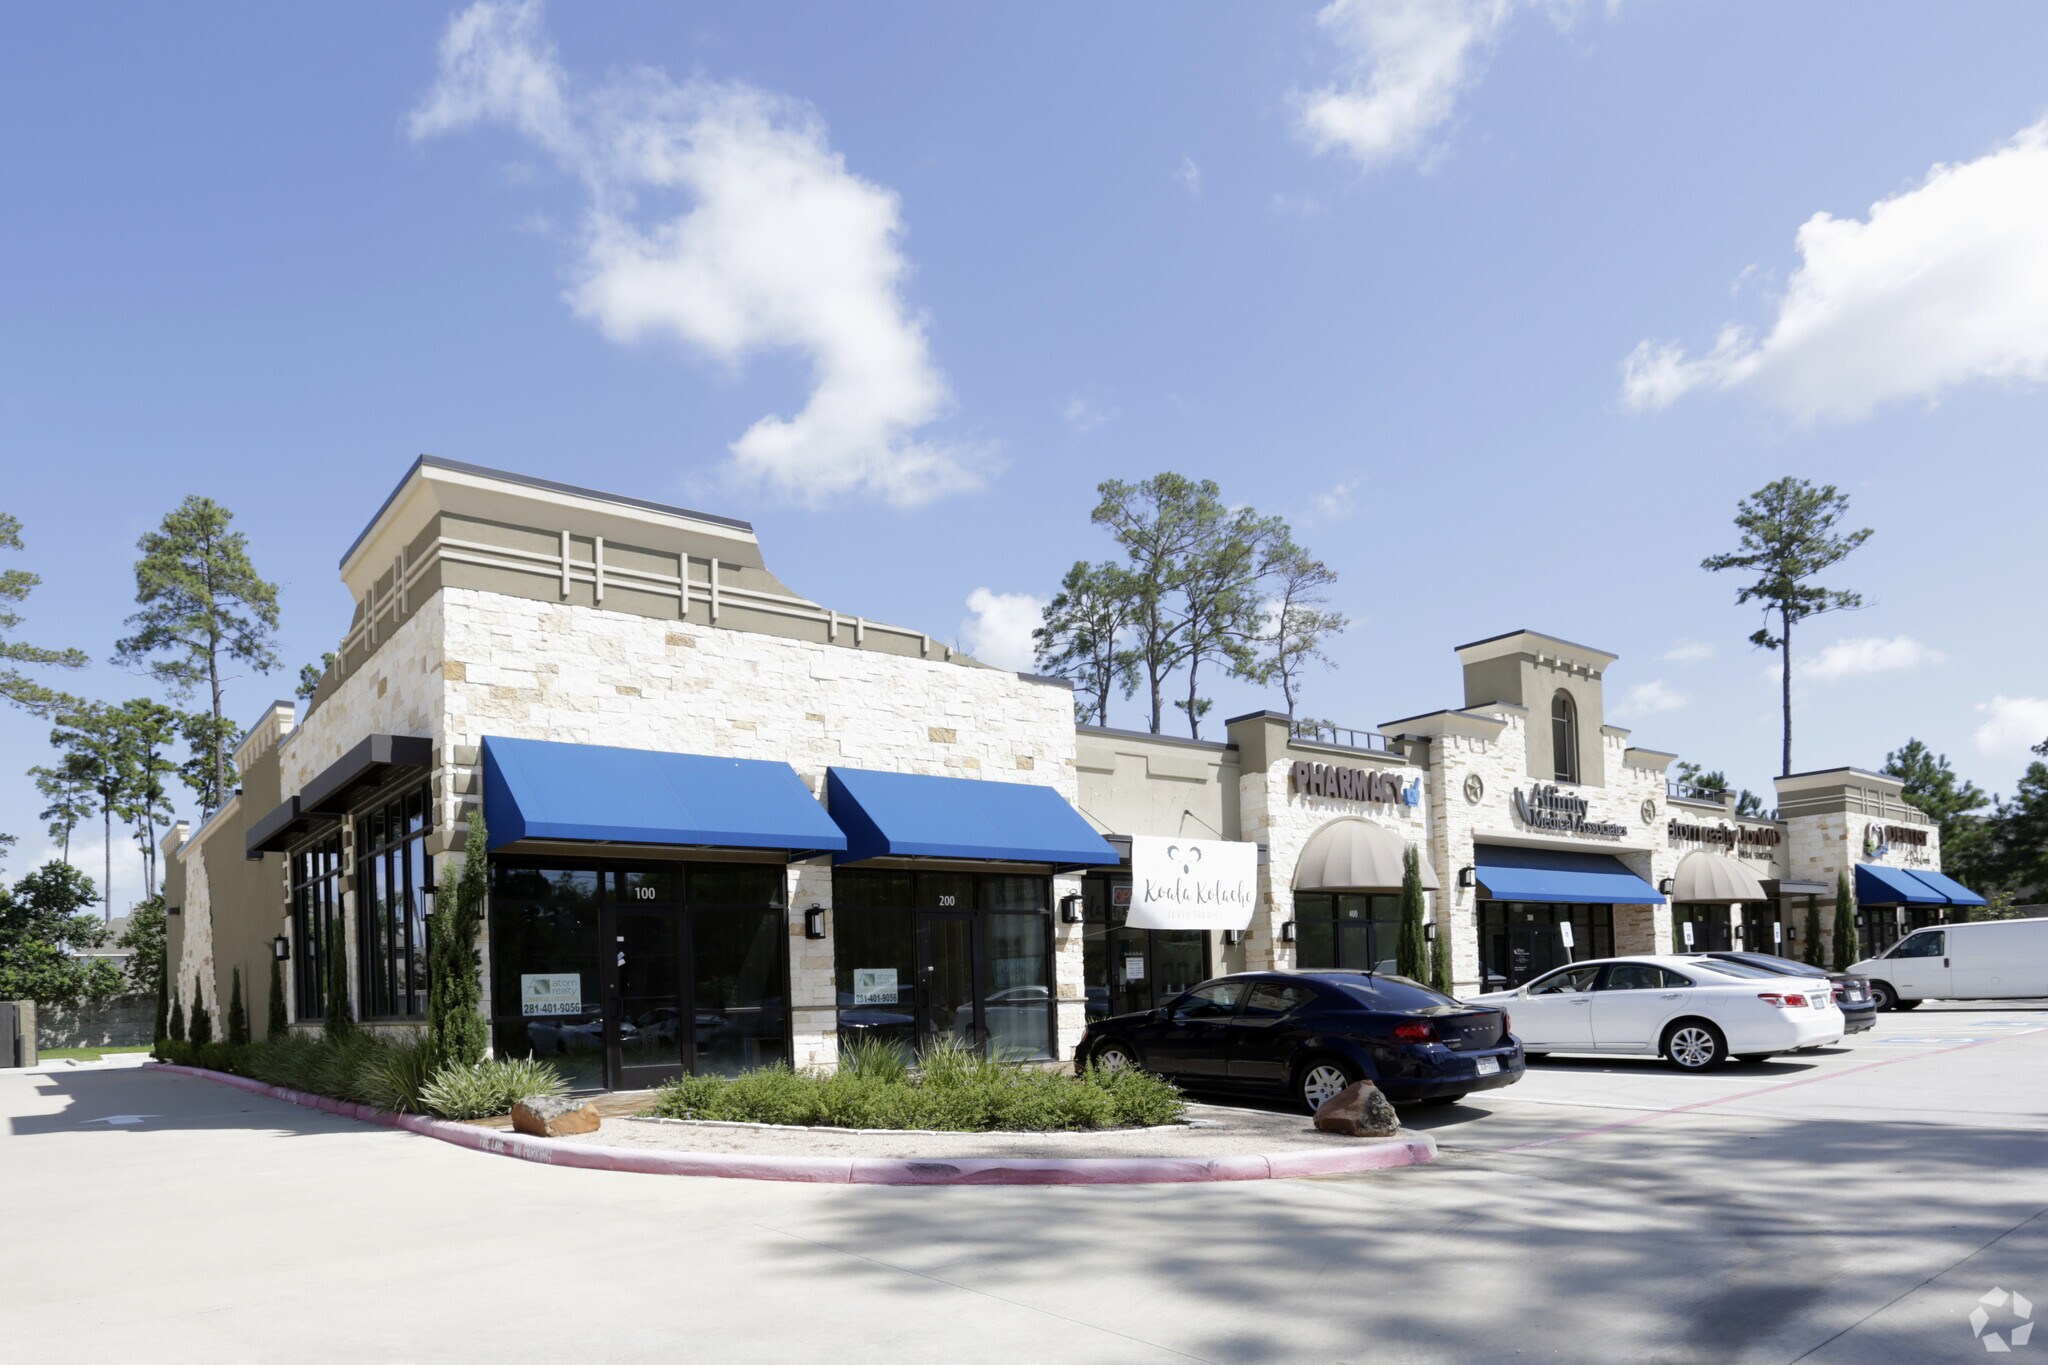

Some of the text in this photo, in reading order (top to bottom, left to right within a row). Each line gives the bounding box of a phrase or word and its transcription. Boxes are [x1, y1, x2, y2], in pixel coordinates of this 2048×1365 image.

[1293, 761, 1404, 804] PHARMACY
[1528, 783, 1589, 820] Affinity
[1530, 809, 1628, 836] Medical Associates
[1668, 818, 1738, 851] atom realty
[1885, 825, 1928, 846] DENTIST
[634, 887, 656, 900] 100
[939, 895, 956, 906] 200
[1115, 889, 1132, 903] OP
[1144, 877, 1251, 907] Koala Kolache
[552, 980, 578, 988] atom
[552, 987, 579, 998] realty
[523, 1002, 581, 1014] 281-401-9056
